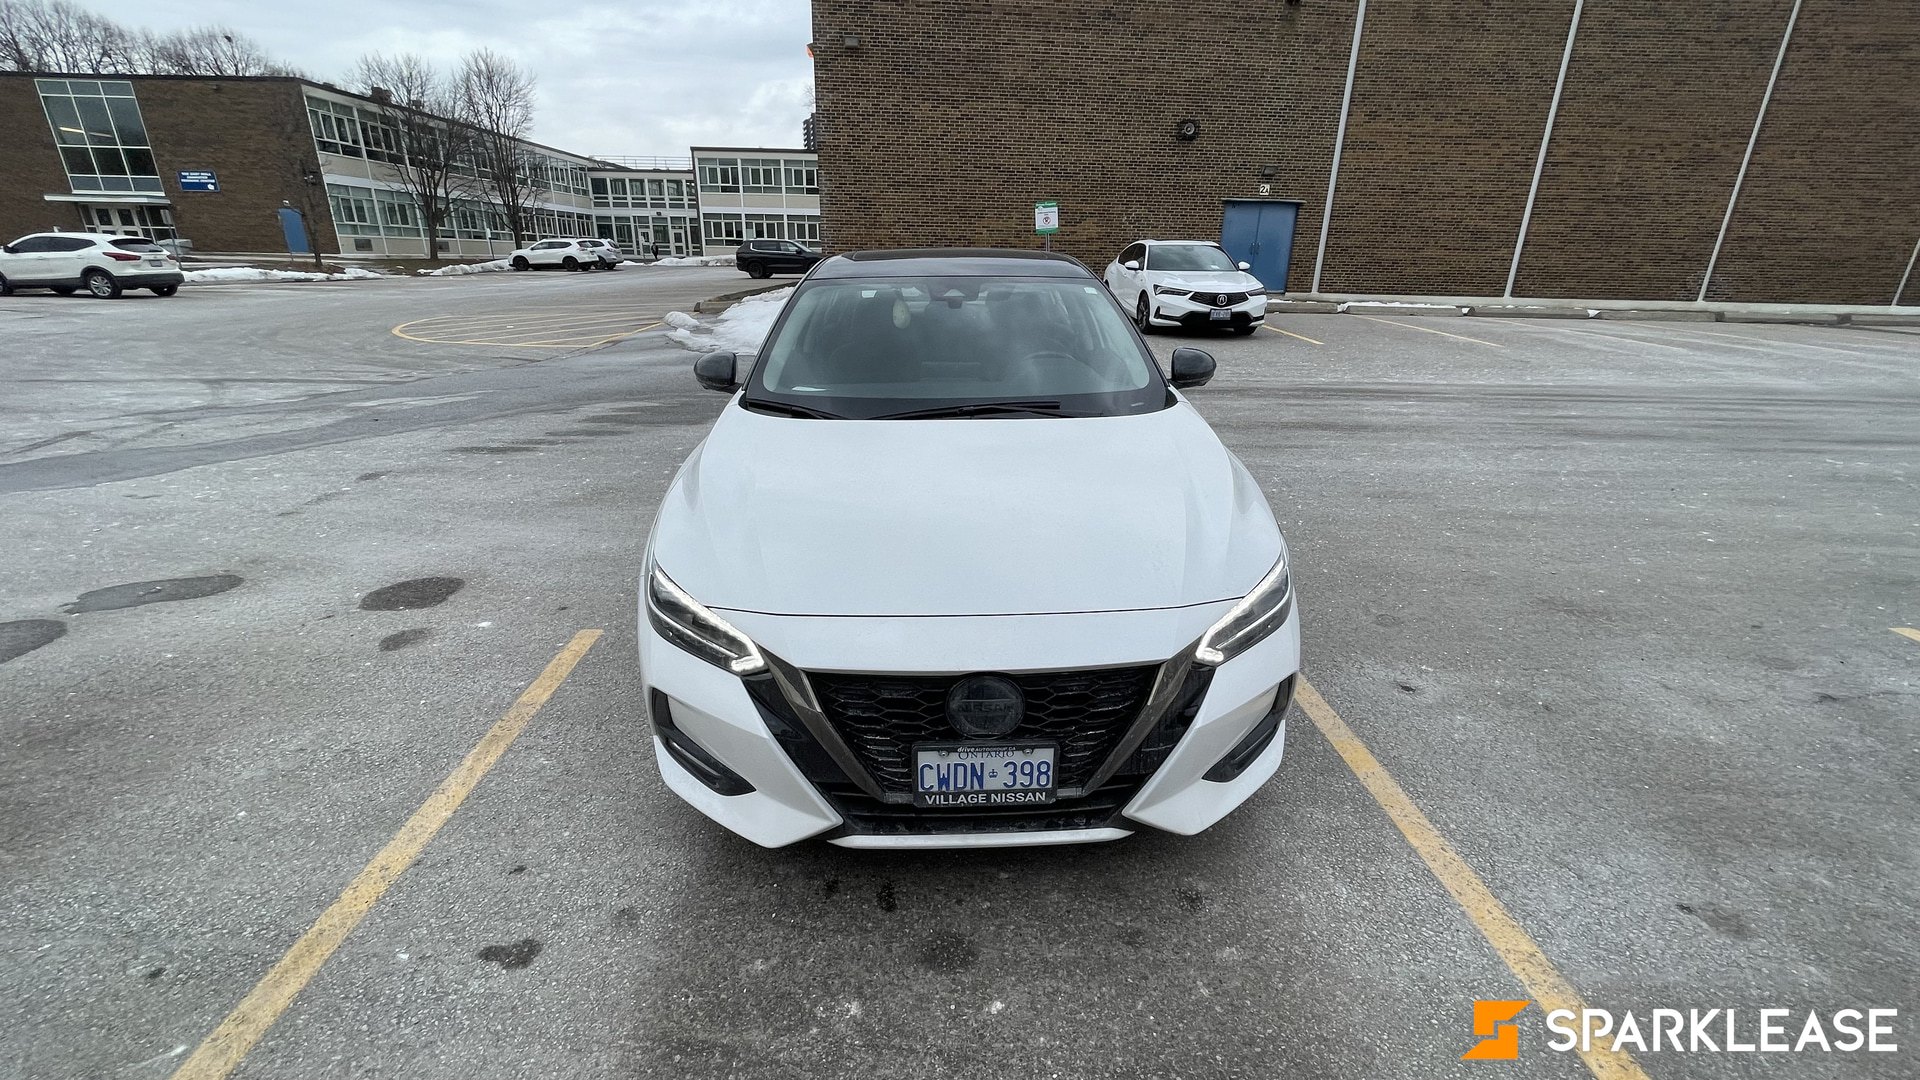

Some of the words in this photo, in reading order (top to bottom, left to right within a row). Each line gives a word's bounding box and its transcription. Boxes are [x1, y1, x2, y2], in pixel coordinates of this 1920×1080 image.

[958, 750, 1015, 760] ONTARIO
[920, 762, 985, 791] CWDN
[1003, 761, 1050, 788] 398
[925, 793, 987, 805] VILLAGE
[990, 792, 1046, 803] NISSAN
